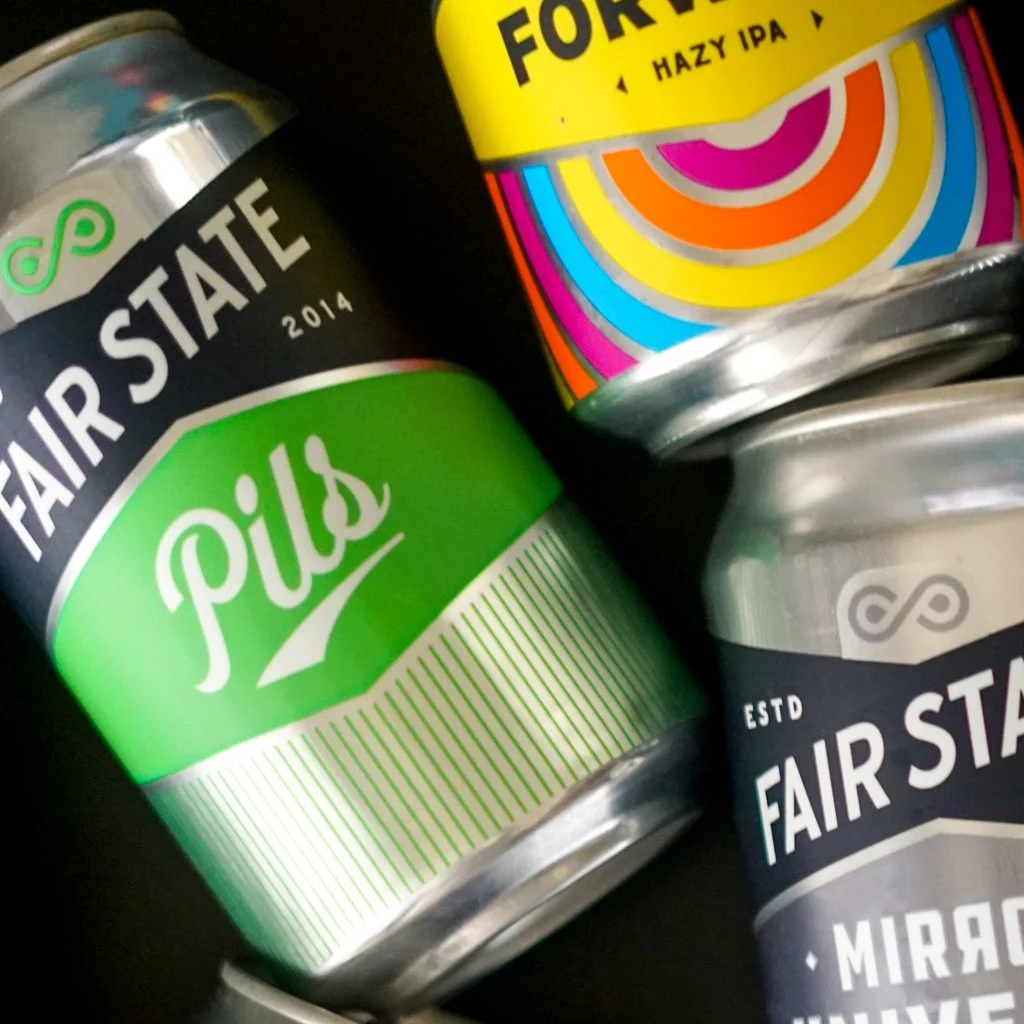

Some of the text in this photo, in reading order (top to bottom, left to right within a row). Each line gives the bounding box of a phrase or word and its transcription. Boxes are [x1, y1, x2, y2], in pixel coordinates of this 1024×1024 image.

[496, 0, 731, 88] FOR
[652, 19, 787, 82] HAZY IPA
[281, 291, 355, 340] 2014
[0, 177, 312, 563] FAIR STATE
[155, 434, 392, 694] Pils
[743, 694, 803, 730] ESTD
[754, 721, 891, 867] FAIR
